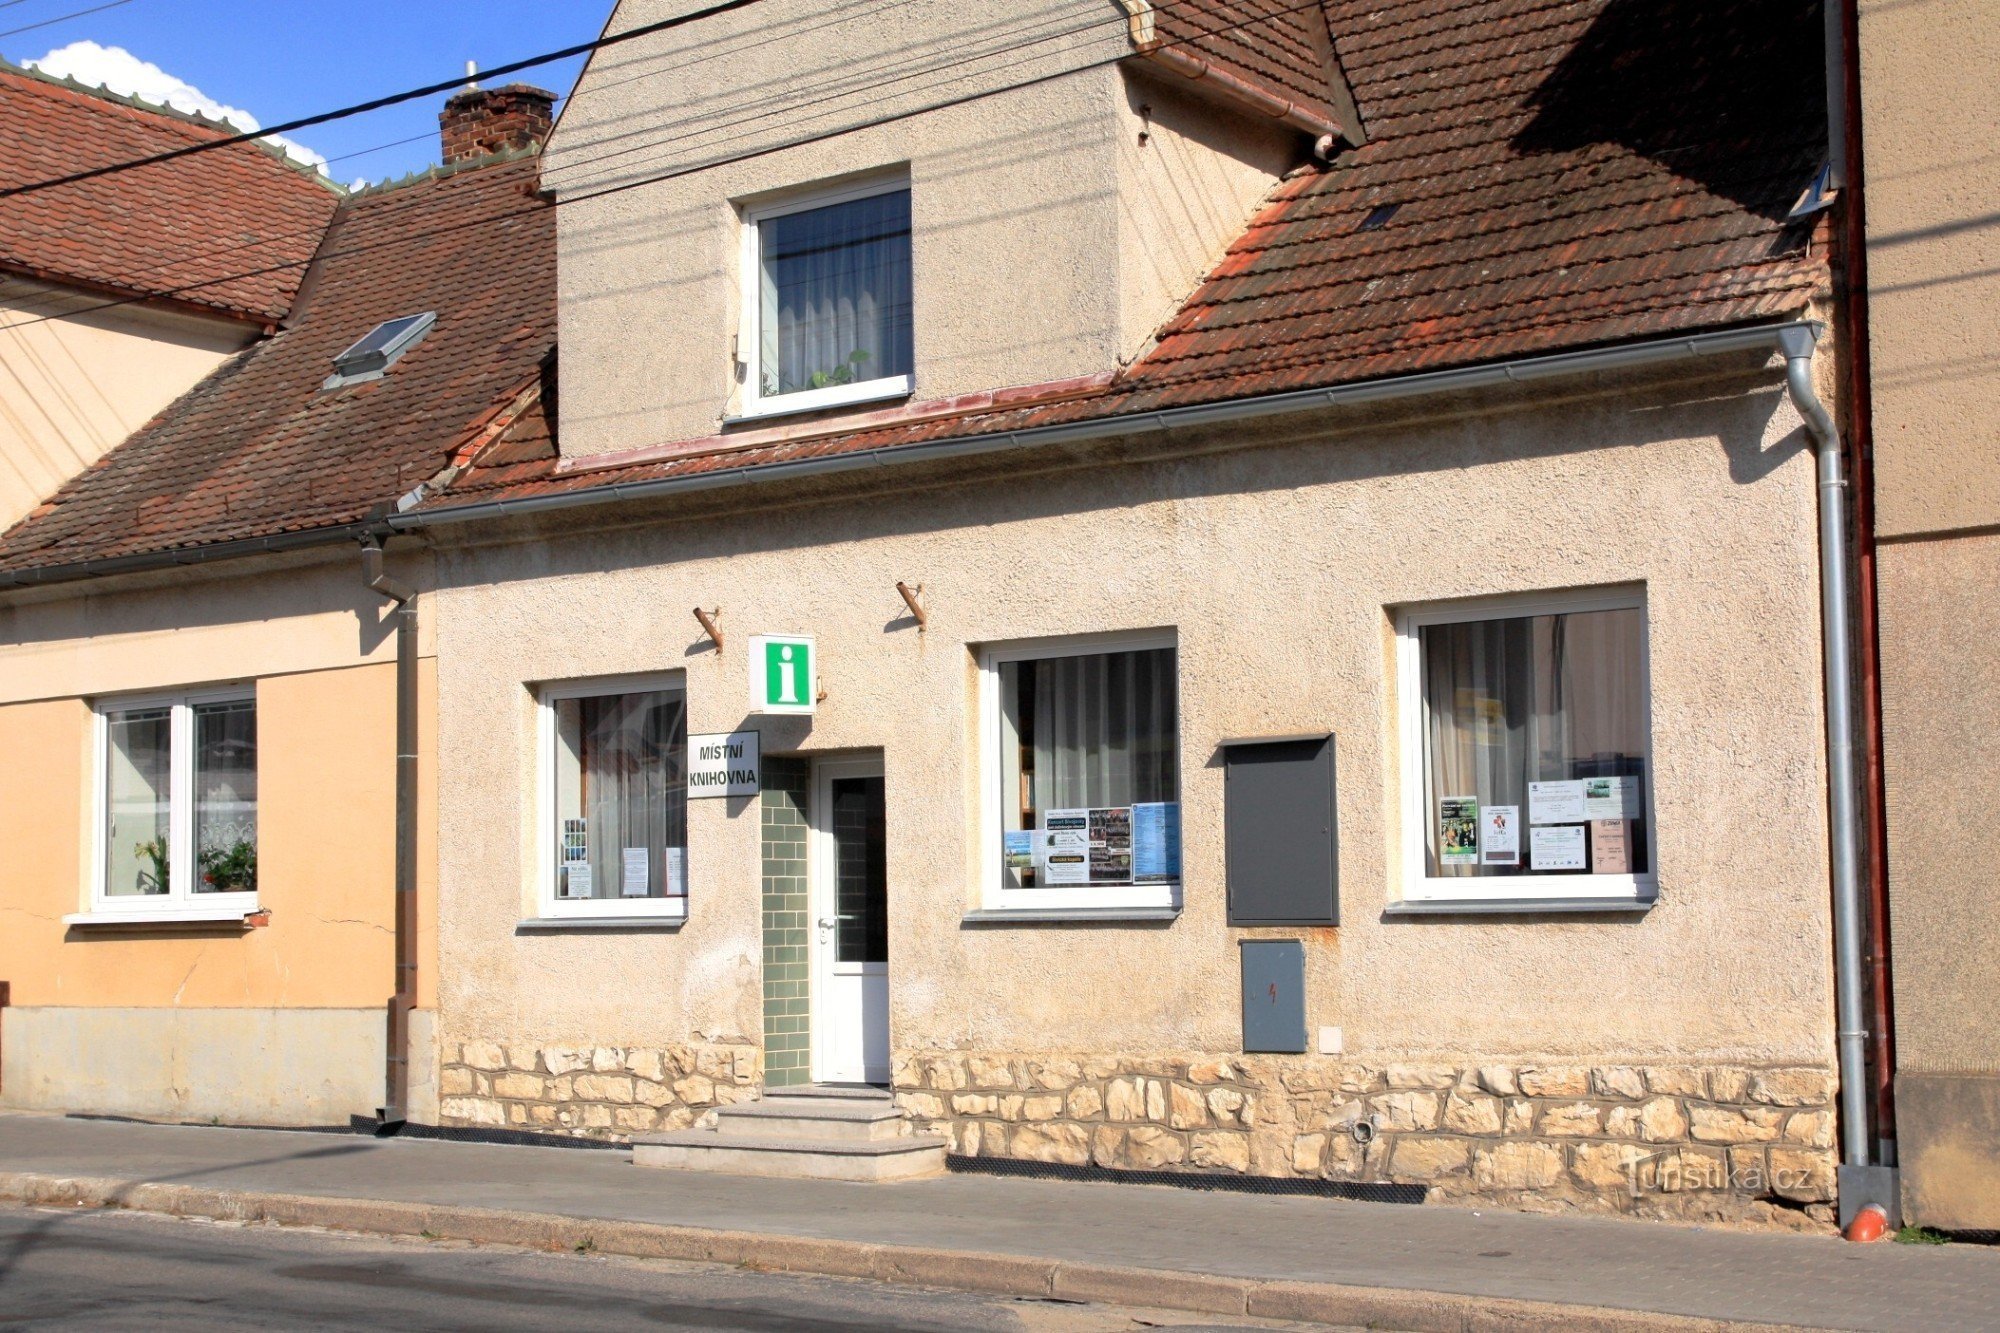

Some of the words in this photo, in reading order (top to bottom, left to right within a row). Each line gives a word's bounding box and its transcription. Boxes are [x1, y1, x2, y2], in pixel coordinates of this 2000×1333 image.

[778, 645, 799, 703] i
[699, 740, 744, 761] MÍSTNÍ
[689, 769, 756, 787] KNIHOVNA
